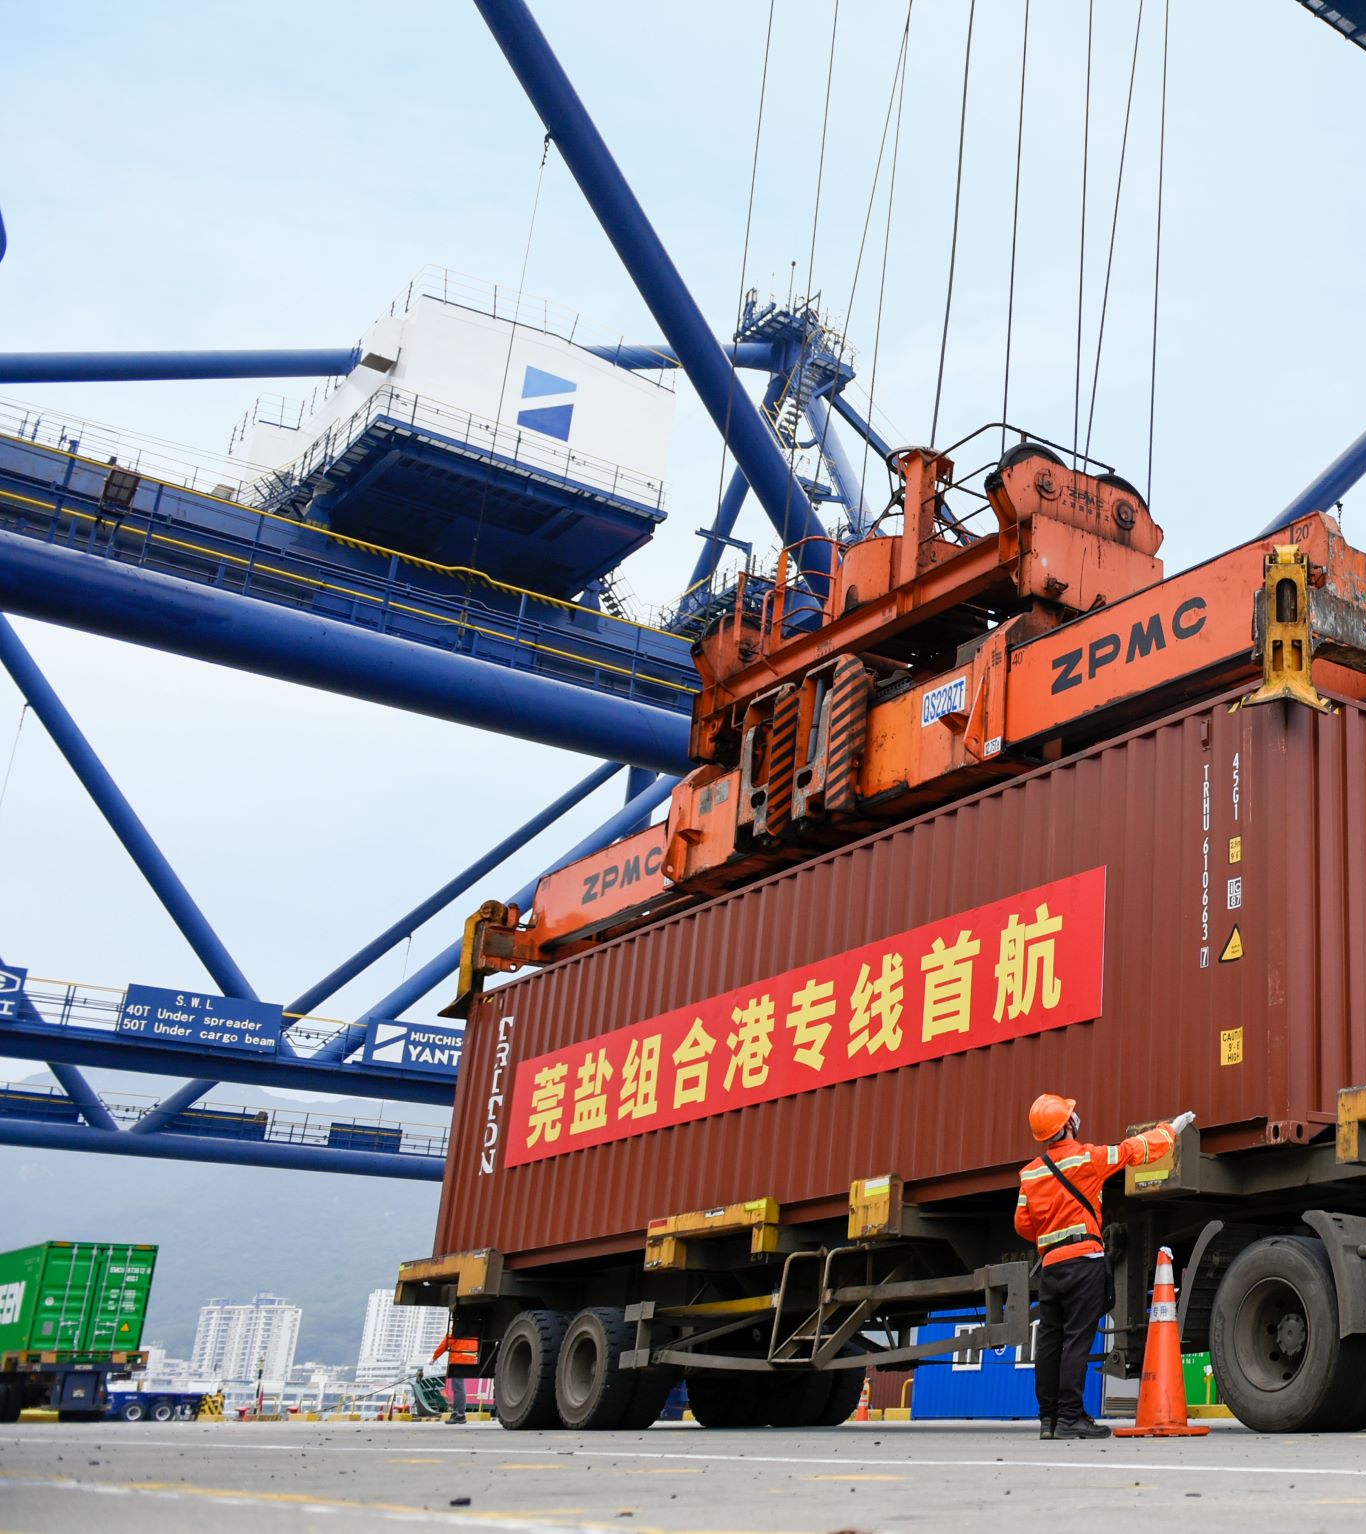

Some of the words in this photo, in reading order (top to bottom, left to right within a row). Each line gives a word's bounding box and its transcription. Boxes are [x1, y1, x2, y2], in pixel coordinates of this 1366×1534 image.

[1051, 596, 1208, 696] ZPMC
[1231, 752, 1239, 821] 45G1
[581, 846, 663, 906] ZPMC
[1201, 947, 1209, 967] 7
[122, 1018, 148, 1032] 50T
[154, 1022, 192, 1037] Under
[199, 1030, 238, 1043] cargo
[244, 1034, 275, 1048] beam
[126, 1004, 151, 1018] 40T
[157, 1008, 196, 1024] Under
[203, 1015, 262, 1032] spreader
[525, 902, 1064, 1149] 莞盐组合港专线首航
